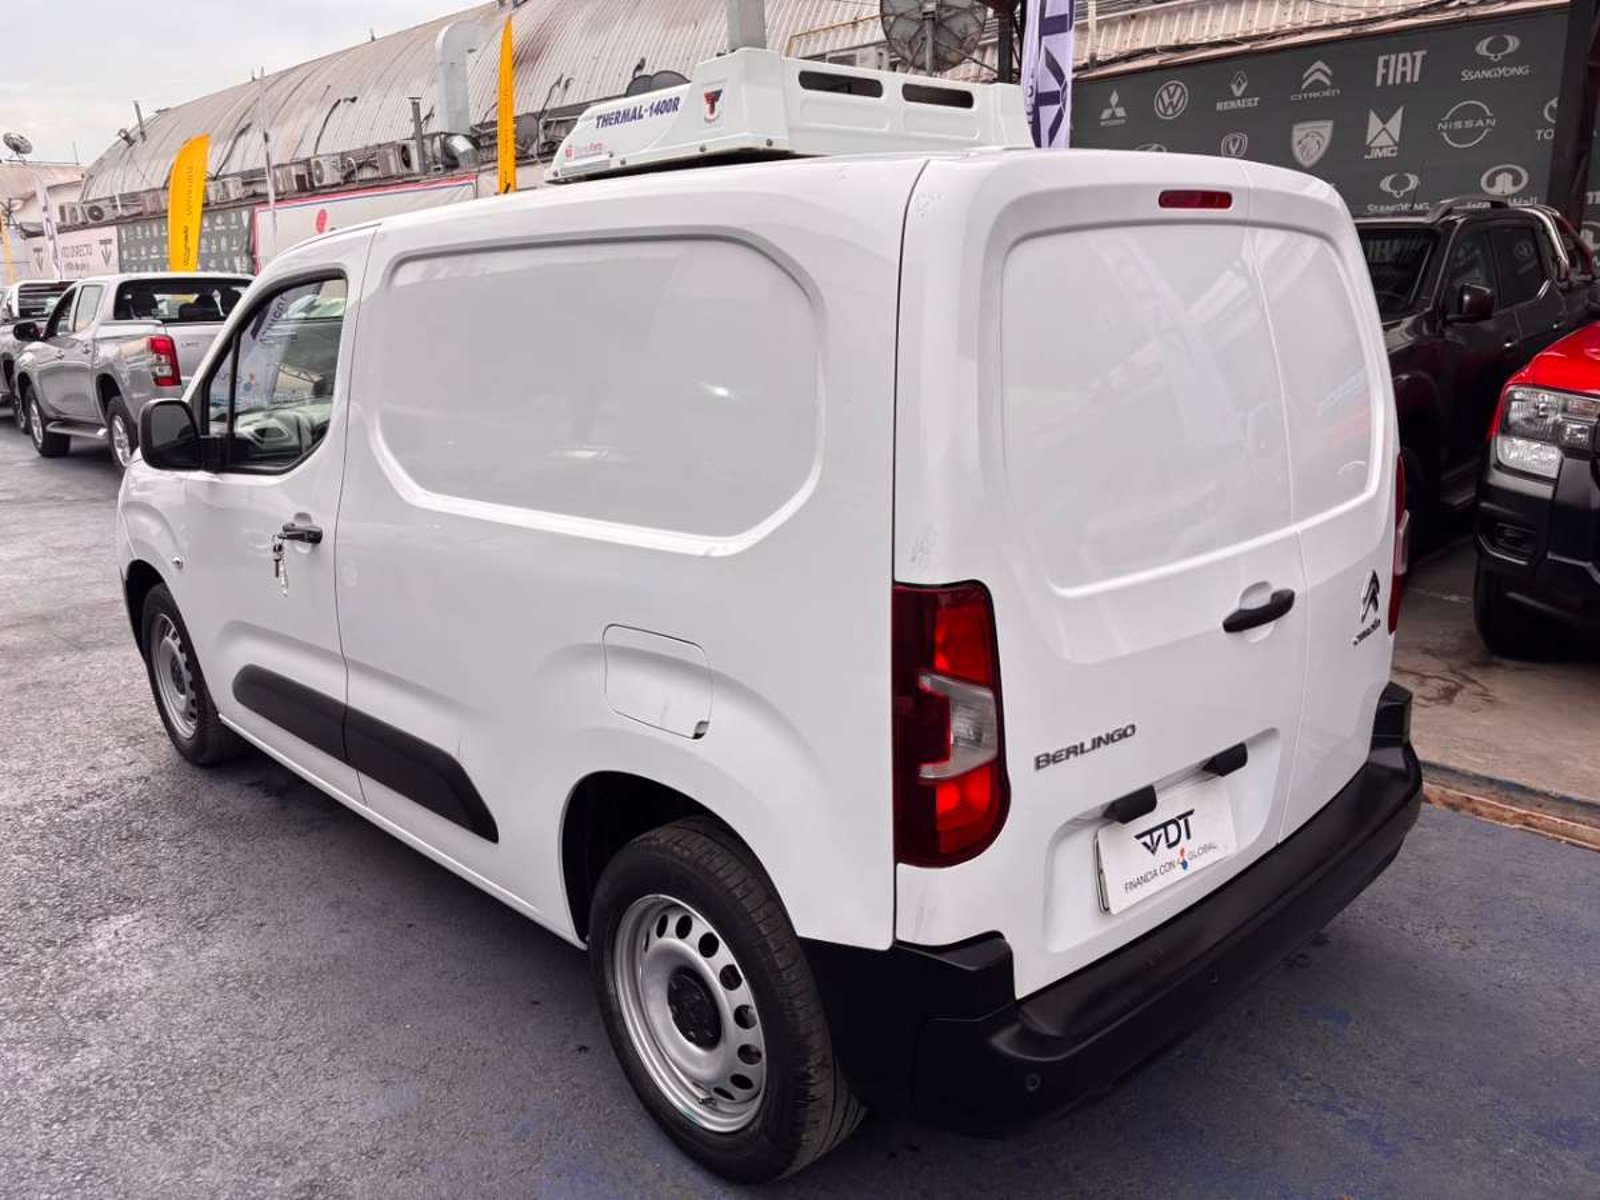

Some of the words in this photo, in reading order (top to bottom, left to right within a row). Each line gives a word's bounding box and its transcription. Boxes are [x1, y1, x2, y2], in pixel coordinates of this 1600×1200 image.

[1375, 50, 1428, 87] FIAT
[1216, 97, 1260, 111] RENAULT
[1437, 118, 1497, 131] NISSAN
[1363, 146, 1399, 159] JMC
[1034, 723, 1137, 771] BERLINGO
[1123, 866, 1159, 894] FINANCIA
[1159, 856, 1176, 876] CON
